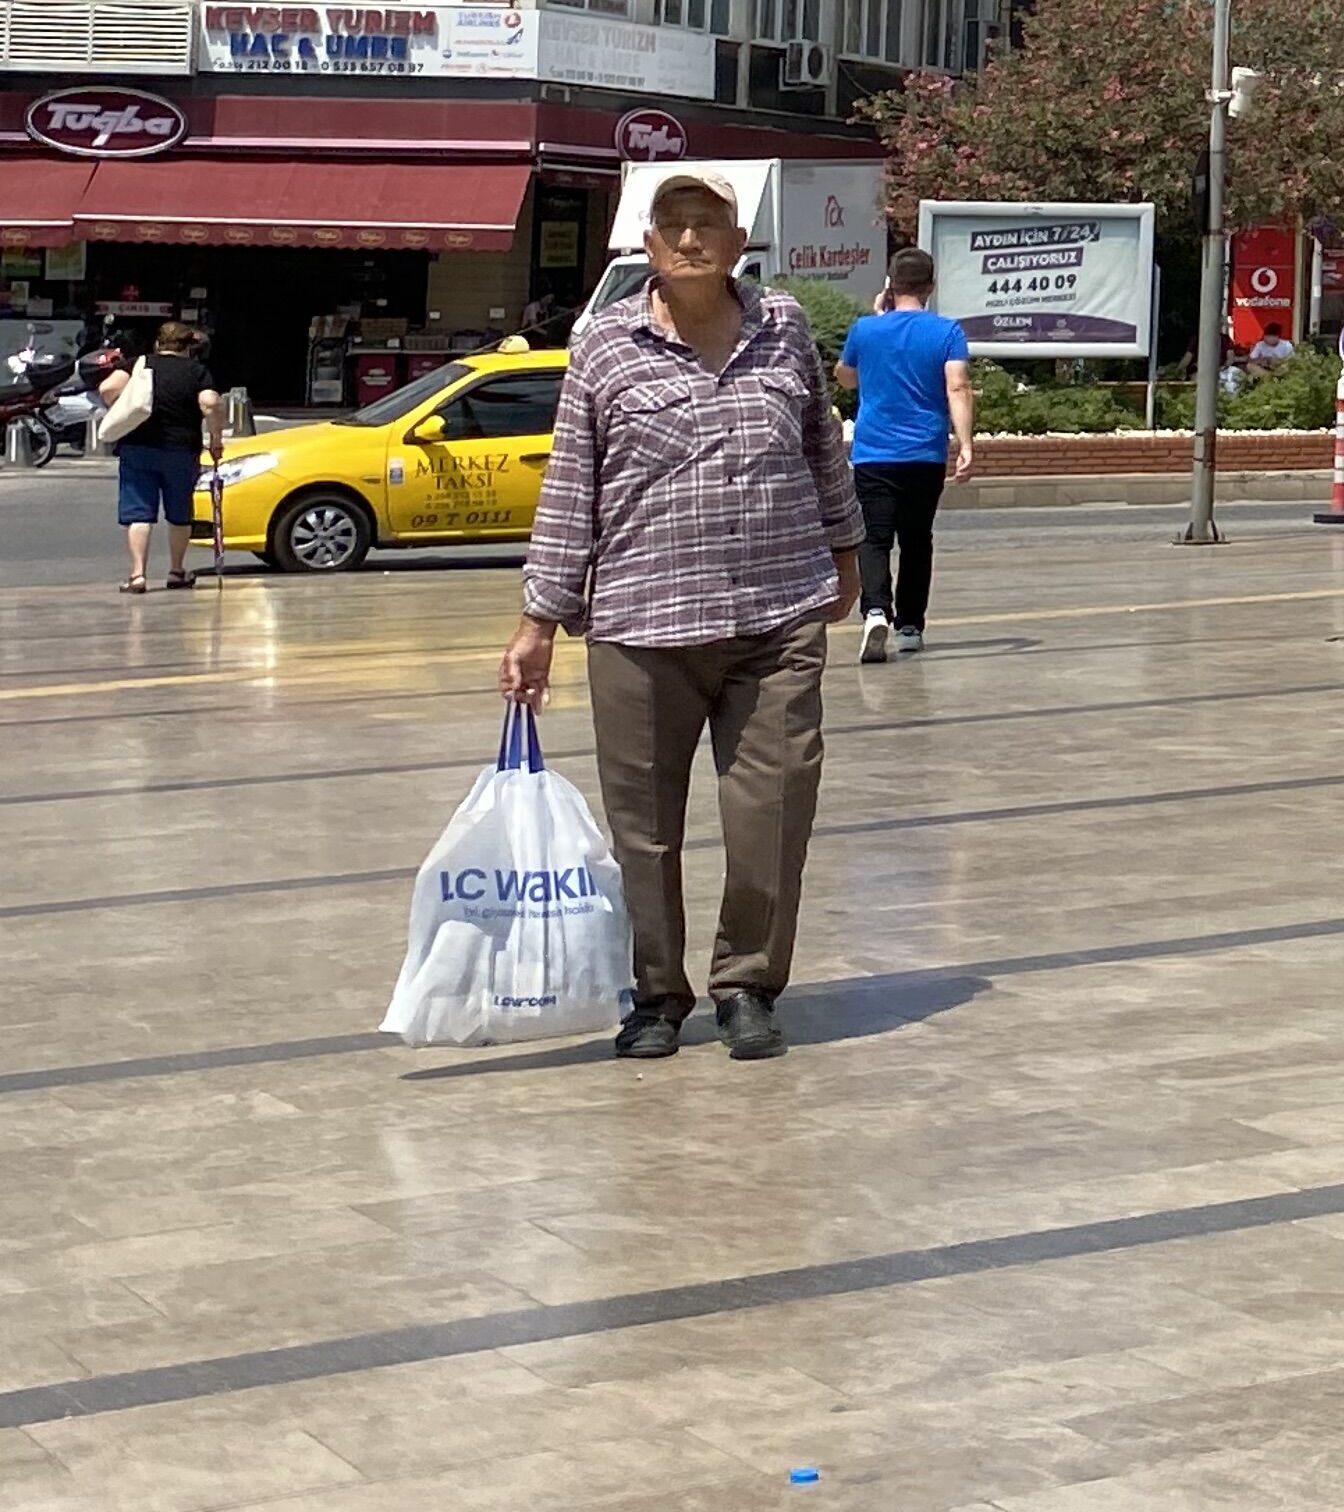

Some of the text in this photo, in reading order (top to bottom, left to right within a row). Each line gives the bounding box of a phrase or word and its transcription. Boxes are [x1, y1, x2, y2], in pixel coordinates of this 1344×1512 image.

[206, 6, 320, 34] KEVSER
[230, 33, 290, 58] HAC
[326, 35, 409, 60] UMRE
[974, 233, 1019, 248] AYDIN
[1020, 228, 1049, 246] İÇİN
[788, 241, 871, 275] Çelik Kardeşler
[987, 250, 1077, 273] ÇALIŞIYORUZ
[987, 273, 1078, 294] 444 40 09
[1235, 295, 1291, 307] vodafone
[415, 453, 509, 478] MERKEZ
[445, 513, 460, 526] T
